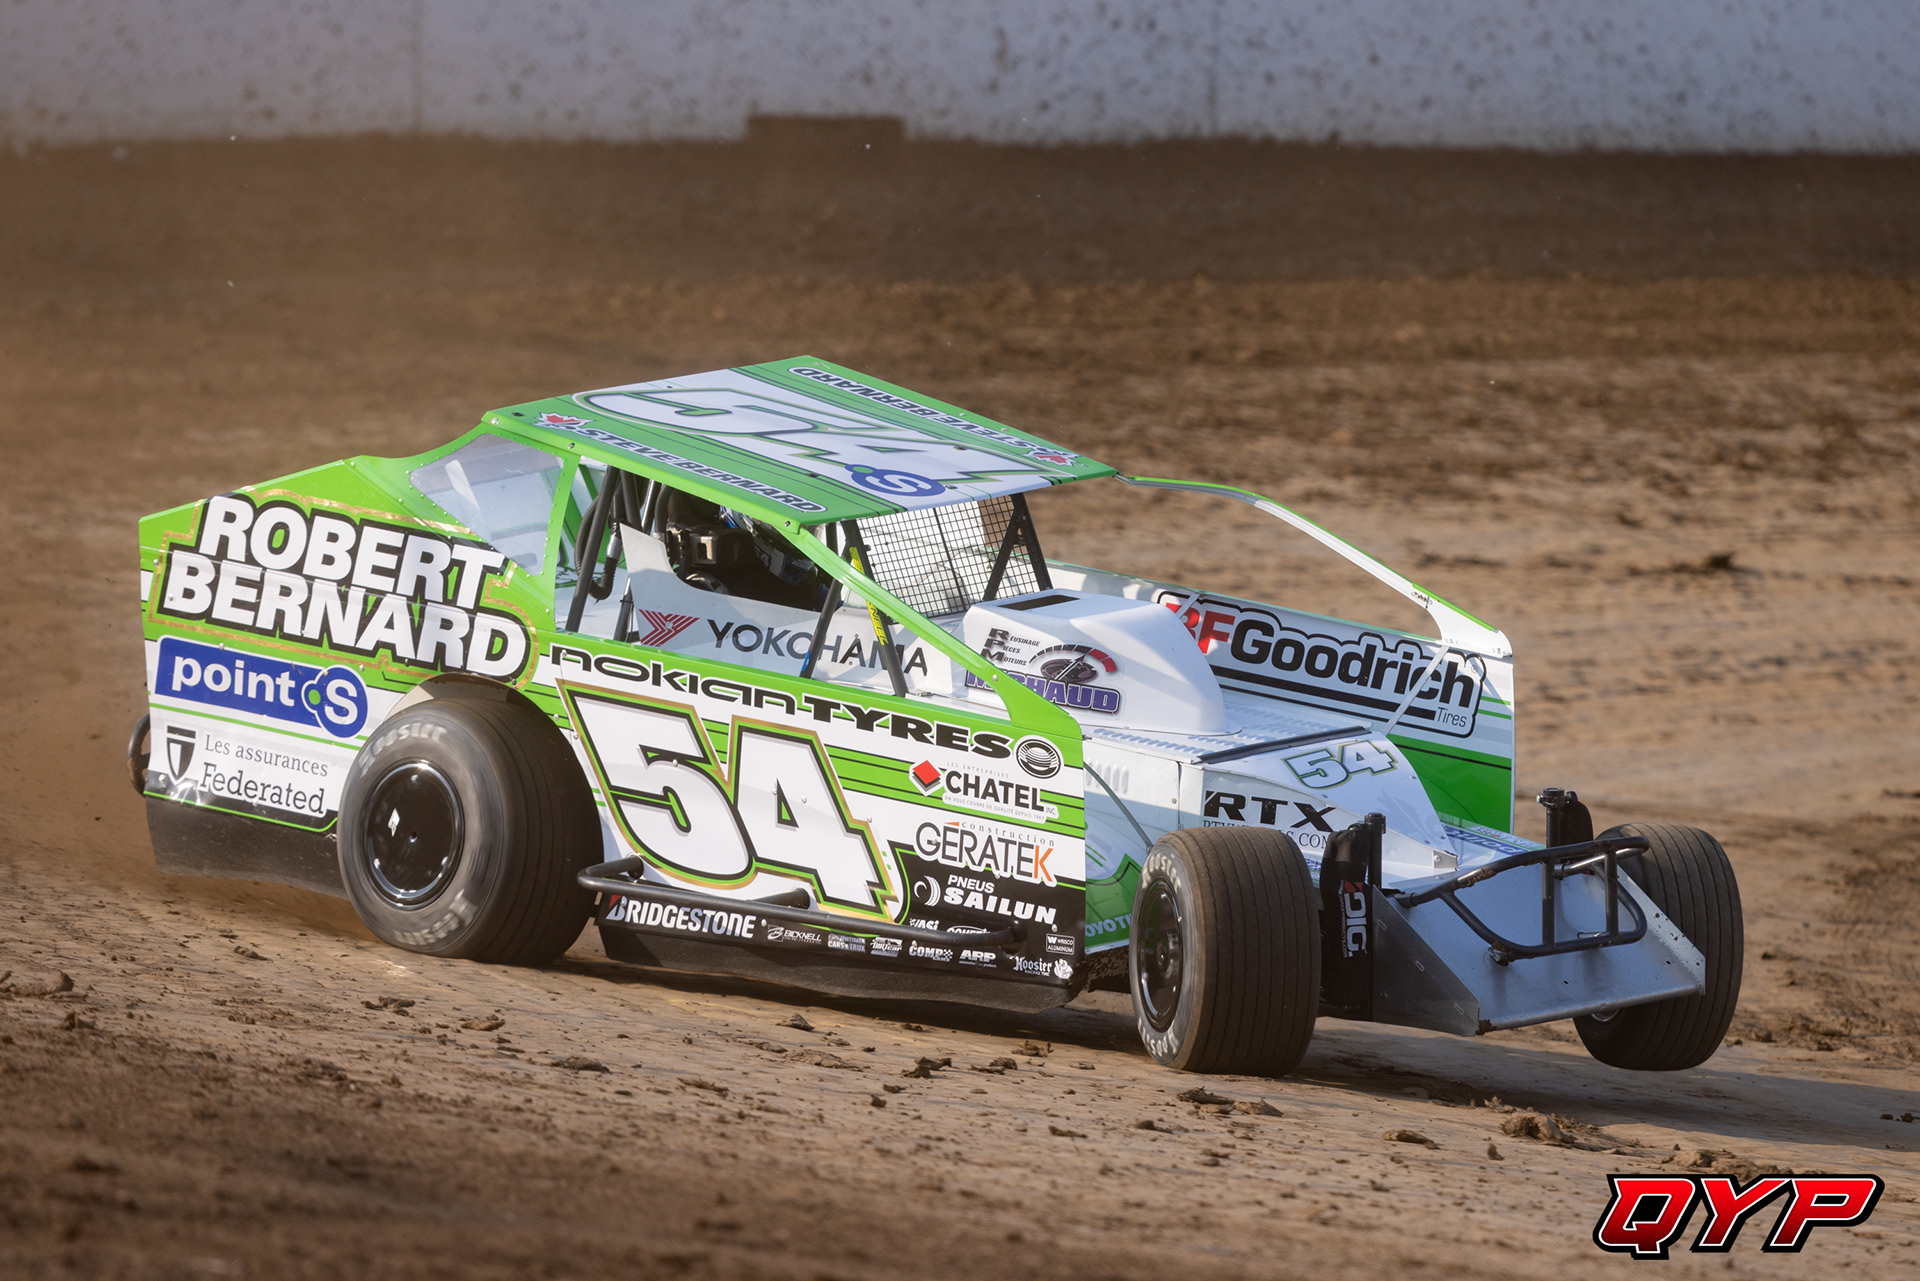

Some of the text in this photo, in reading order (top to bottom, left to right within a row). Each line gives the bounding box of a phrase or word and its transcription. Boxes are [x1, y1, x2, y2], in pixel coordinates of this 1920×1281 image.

[793, 368, 1033, 448] STEVE BERNARD
[583, 429, 822, 511] STEVE BERNARD
[199, 495, 506, 611] ROBERT
[163, 550, 526, 677] BERNARD
[172, 656, 296, 707] point
[803, 697, 1013, 761] TYRES
[1437, 706, 1467, 728] Tires
[205, 734, 329, 777] Les assurances
[1282, 741, 1398, 789] 54
[200, 762, 325, 814] Federated
[566, 689, 888, 916] 54
[945, 770, 1045, 813] CHATEL
[1203, 791, 1337, 833] RTX
[962, 822, 1056, 847] construction
[947, 875, 995, 893] PNEUS
[605, 895, 757, 938] BRIDGESTONE
[943, 887, 1057, 925] SAILUN
[909, 946, 943, 958] COMP
[960, 949, 997, 963] ARP
[1013, 957, 1052, 973] Hoosier
